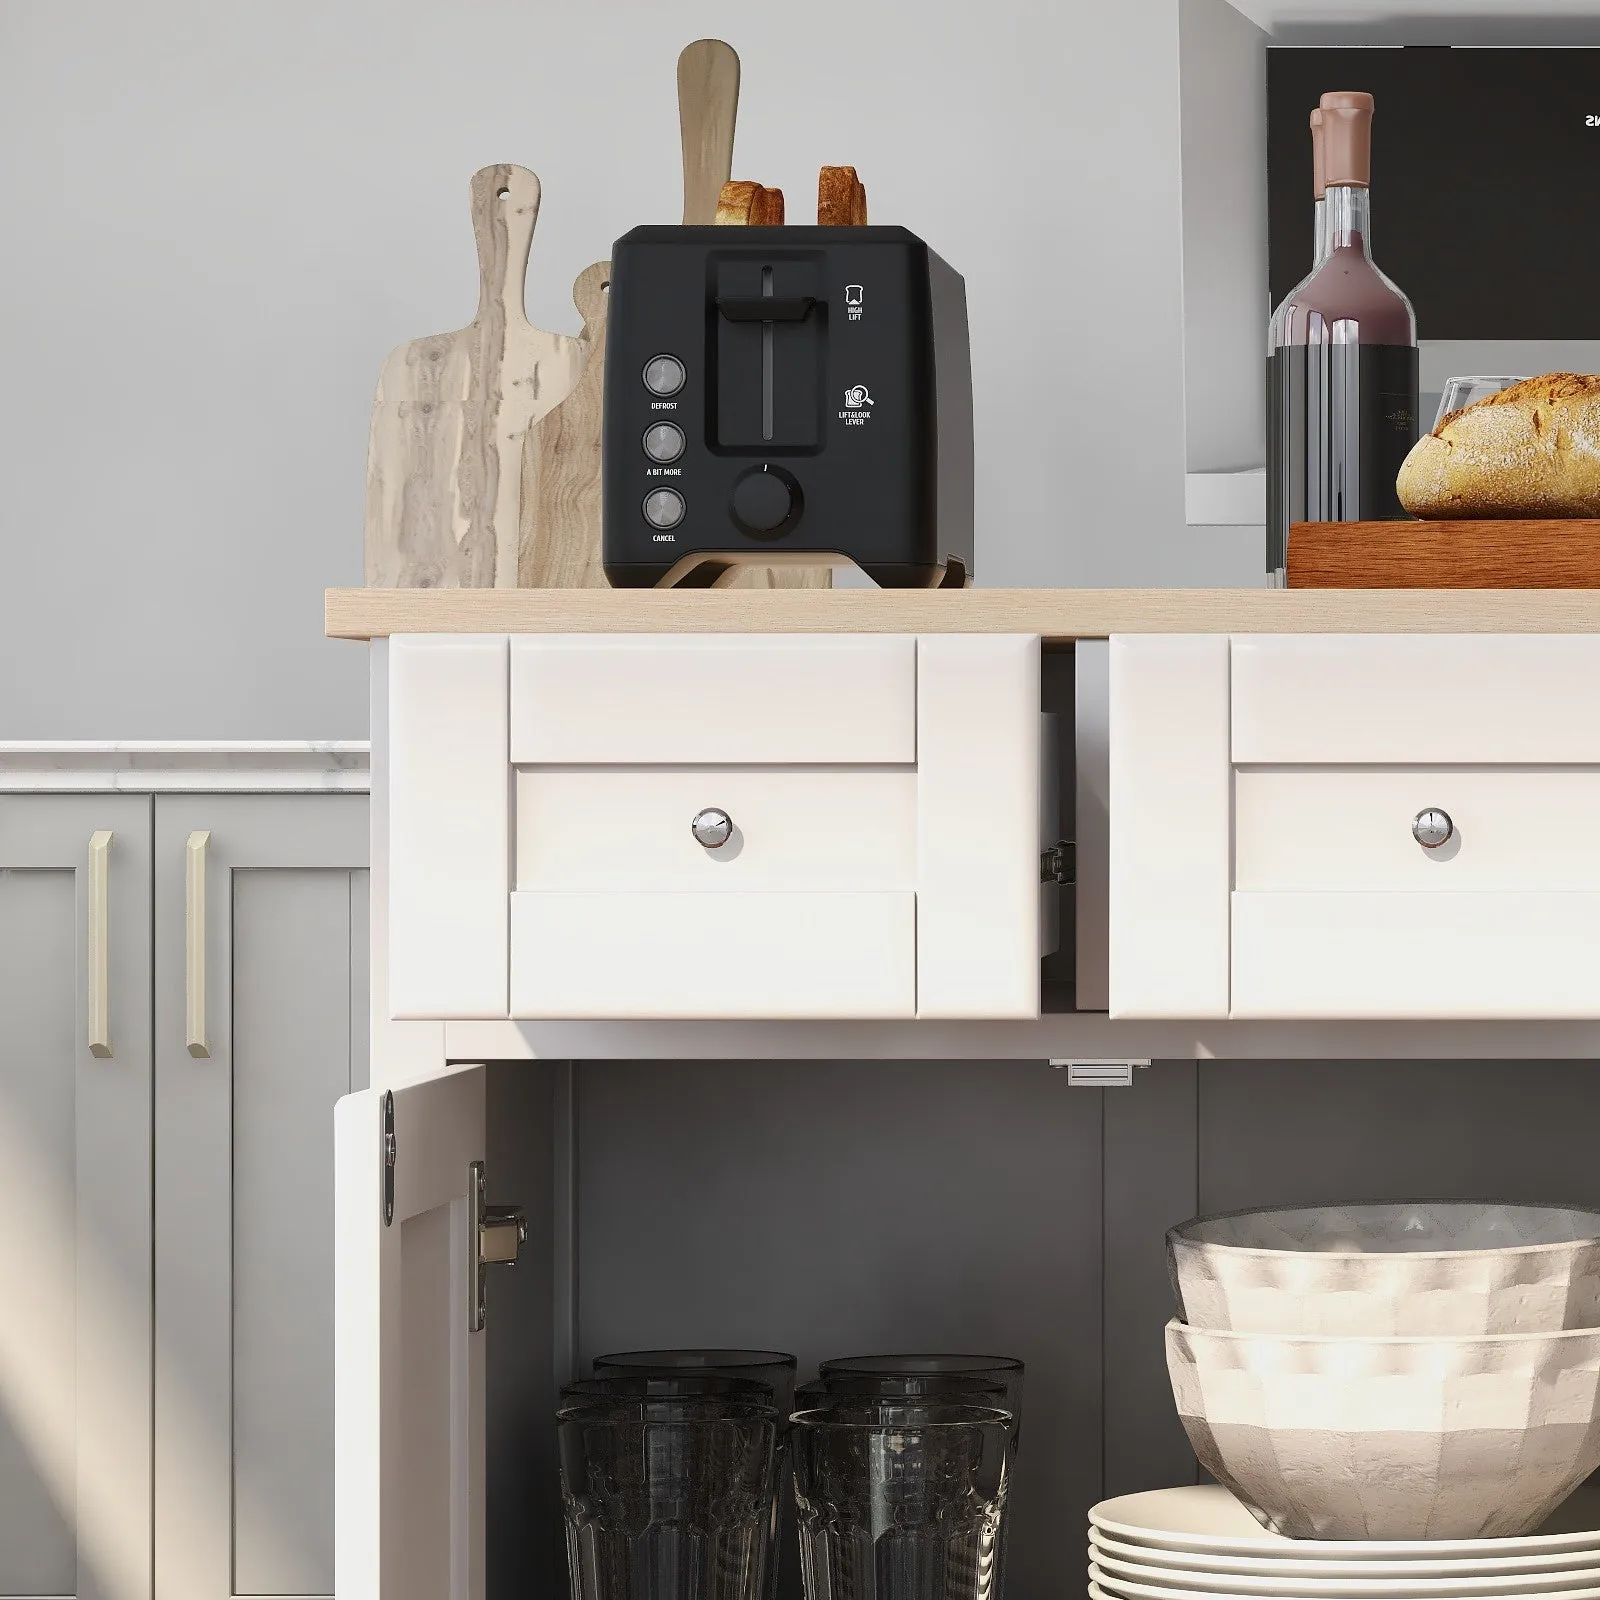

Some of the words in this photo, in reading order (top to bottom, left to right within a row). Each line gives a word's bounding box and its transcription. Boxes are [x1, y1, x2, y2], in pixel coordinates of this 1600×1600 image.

[847, 306, 863, 314] HIGH
[848, 313, 862, 321] LIFT
[651, 402, 678, 410] DEFROST
[838, 411, 871, 419] LIFT&LOOK
[845, 418, 864, 426] LEVER
[646, 468, 652, 476] A
[652, 468, 663, 476] BIT
[663, 468, 682, 476] MORE
[652, 534, 676, 542] CANCEL
